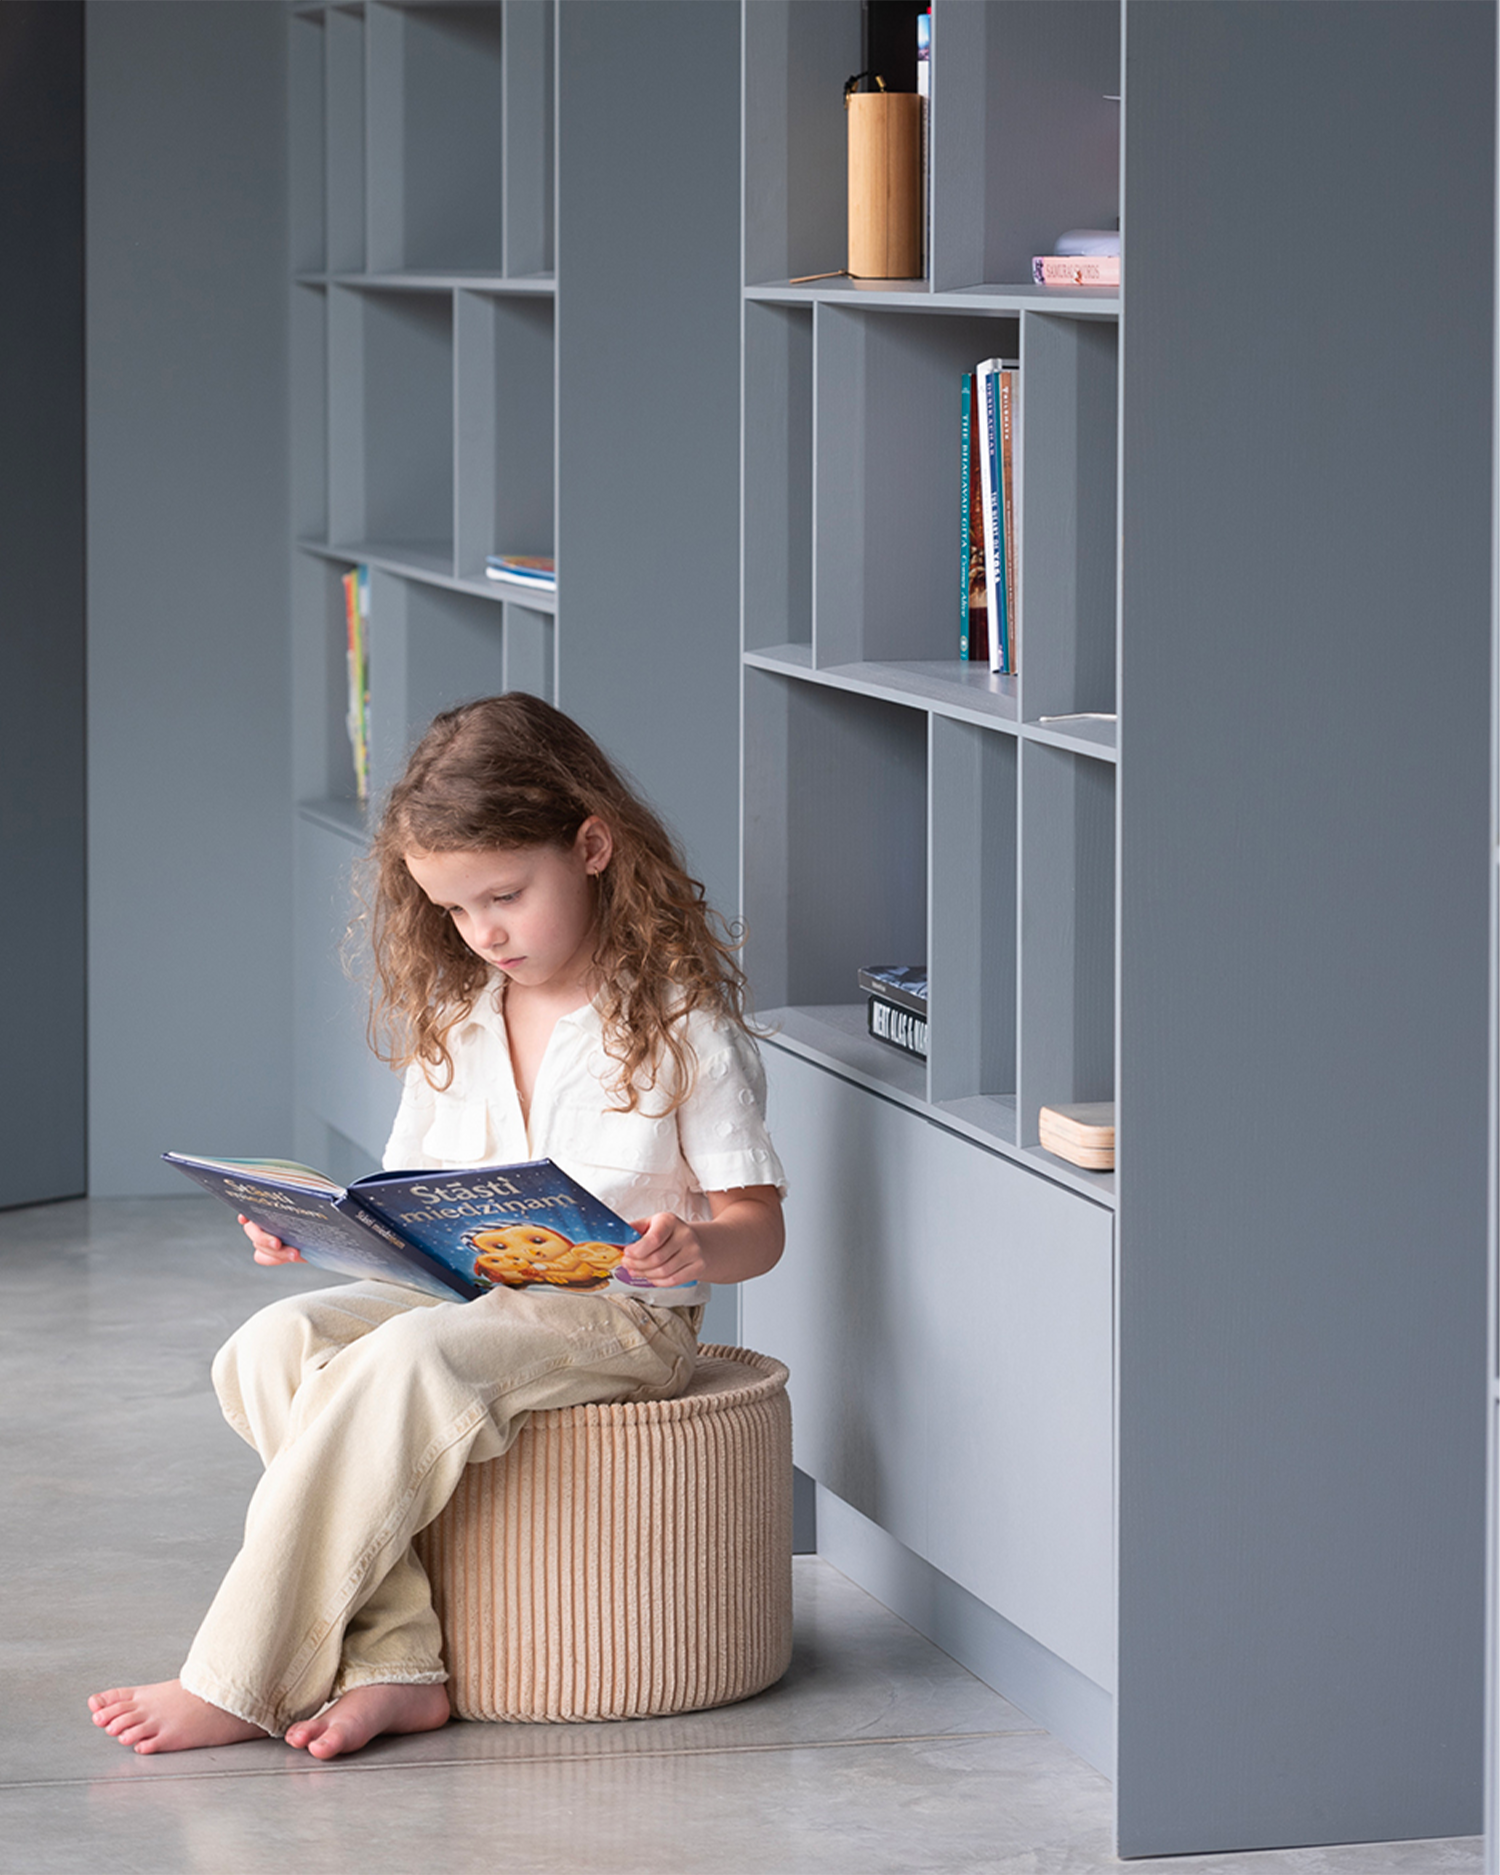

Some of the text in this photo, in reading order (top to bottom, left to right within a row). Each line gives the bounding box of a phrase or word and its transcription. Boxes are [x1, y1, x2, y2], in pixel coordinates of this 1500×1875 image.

[961, 414, 969, 440] THE
[960, 592, 968, 617] Alive
[410, 1176, 523, 1205] Stāsti
[400, 1193, 578, 1224] miedziņam
